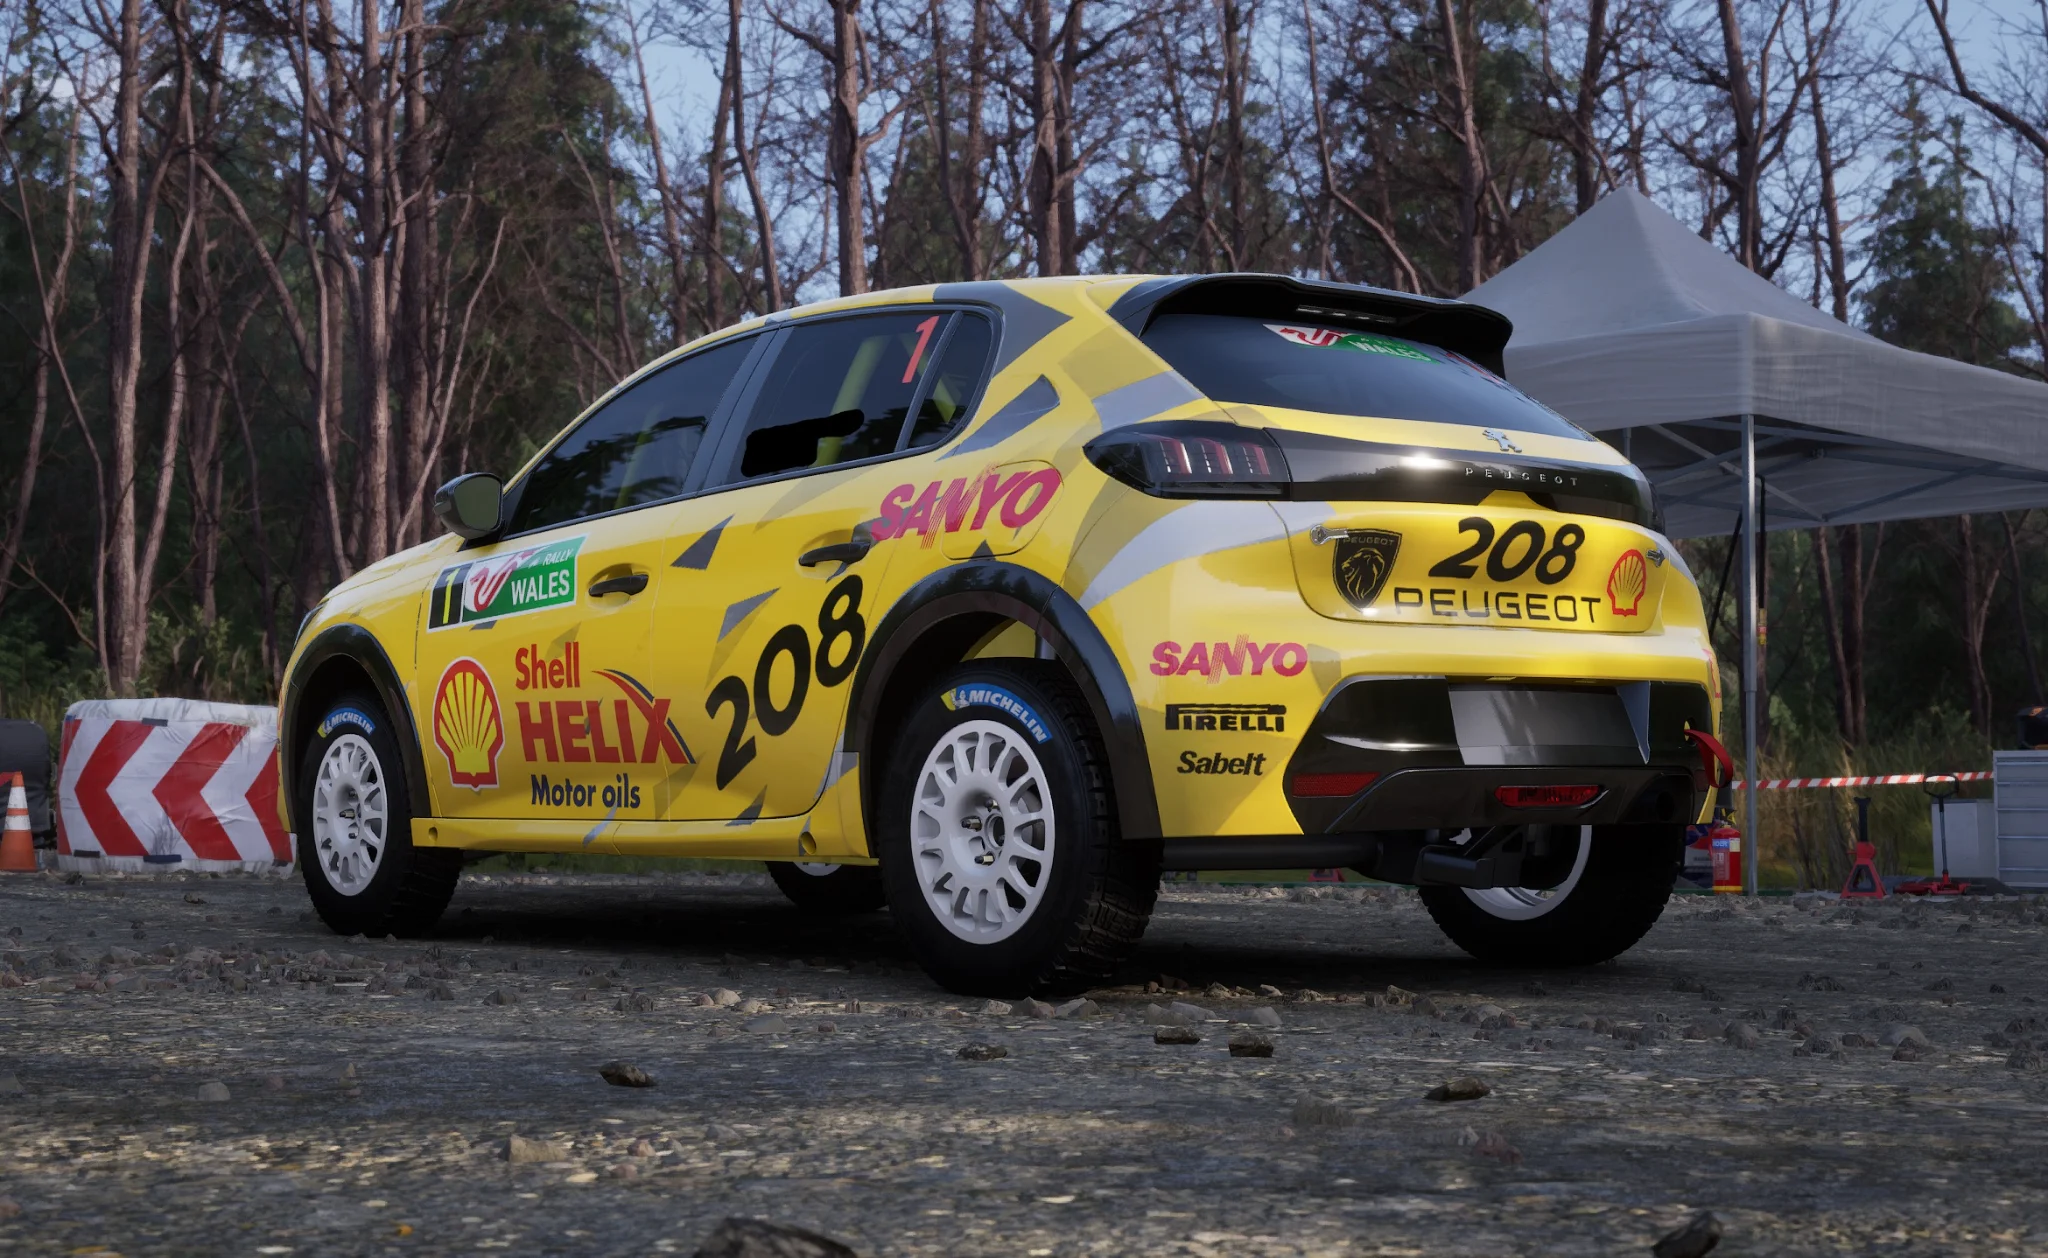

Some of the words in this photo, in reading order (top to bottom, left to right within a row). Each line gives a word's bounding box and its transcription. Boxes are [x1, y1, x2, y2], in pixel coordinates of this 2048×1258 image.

[902, 316, 939, 384] 1
[1465, 467, 1578, 486] PEUGEOT
[871, 463, 1062, 550] SANYO
[543, 549, 573, 566] RALLY
[1428, 516, 1586, 585] 208
[442, 567, 461, 625] 1
[511, 569, 570, 606] WALES
[1394, 587, 1602, 624] PEUGEOT
[515, 641, 581, 691] Shell
[705, 574, 866, 791] 208
[1149, 633, 1308, 684] SANYO
[331, 712, 373, 735] MICHELIN
[515, 680, 697, 765] HELIX
[968, 690, 1048, 742] MICHELIN
[1165, 703, 1287, 732] PIRELLI
[1176, 750, 1267, 776] Sabelt
[531, 774, 597, 807] Motor
[602, 773, 641, 809] oils
